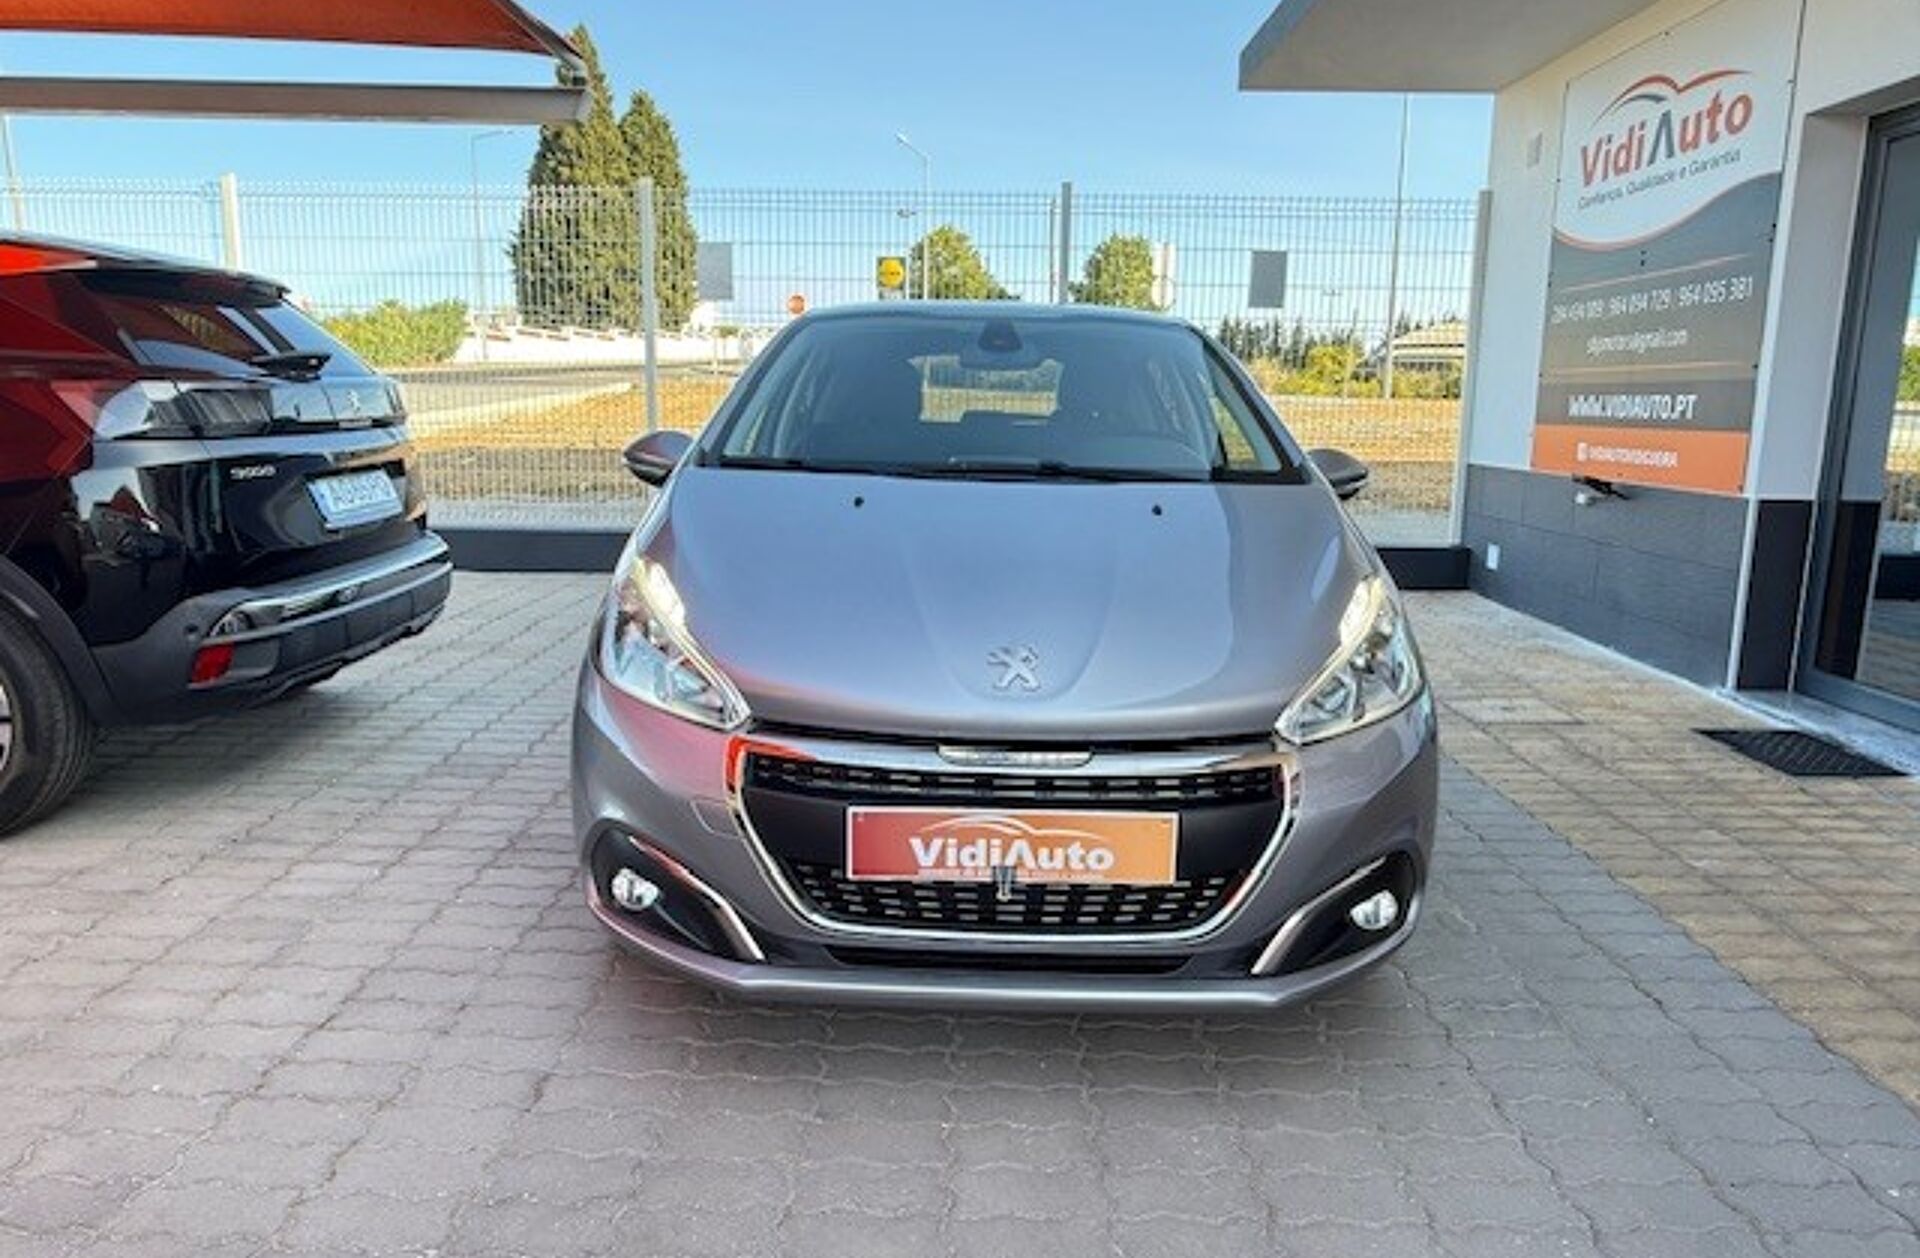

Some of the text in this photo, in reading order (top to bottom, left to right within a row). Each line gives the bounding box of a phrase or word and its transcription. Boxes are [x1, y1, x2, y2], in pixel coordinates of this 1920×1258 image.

[1579, 91, 1753, 187] VidiAuto
[1626, 171, 1675, 195] Qualidade
[1679, 166, 1687, 179] e
[1689, 150, 1741, 176] Garantia
[1568, 395, 1698, 420] WWW.VIDIAUTO.PT
[909, 837, 1116, 871] VidiAuto
